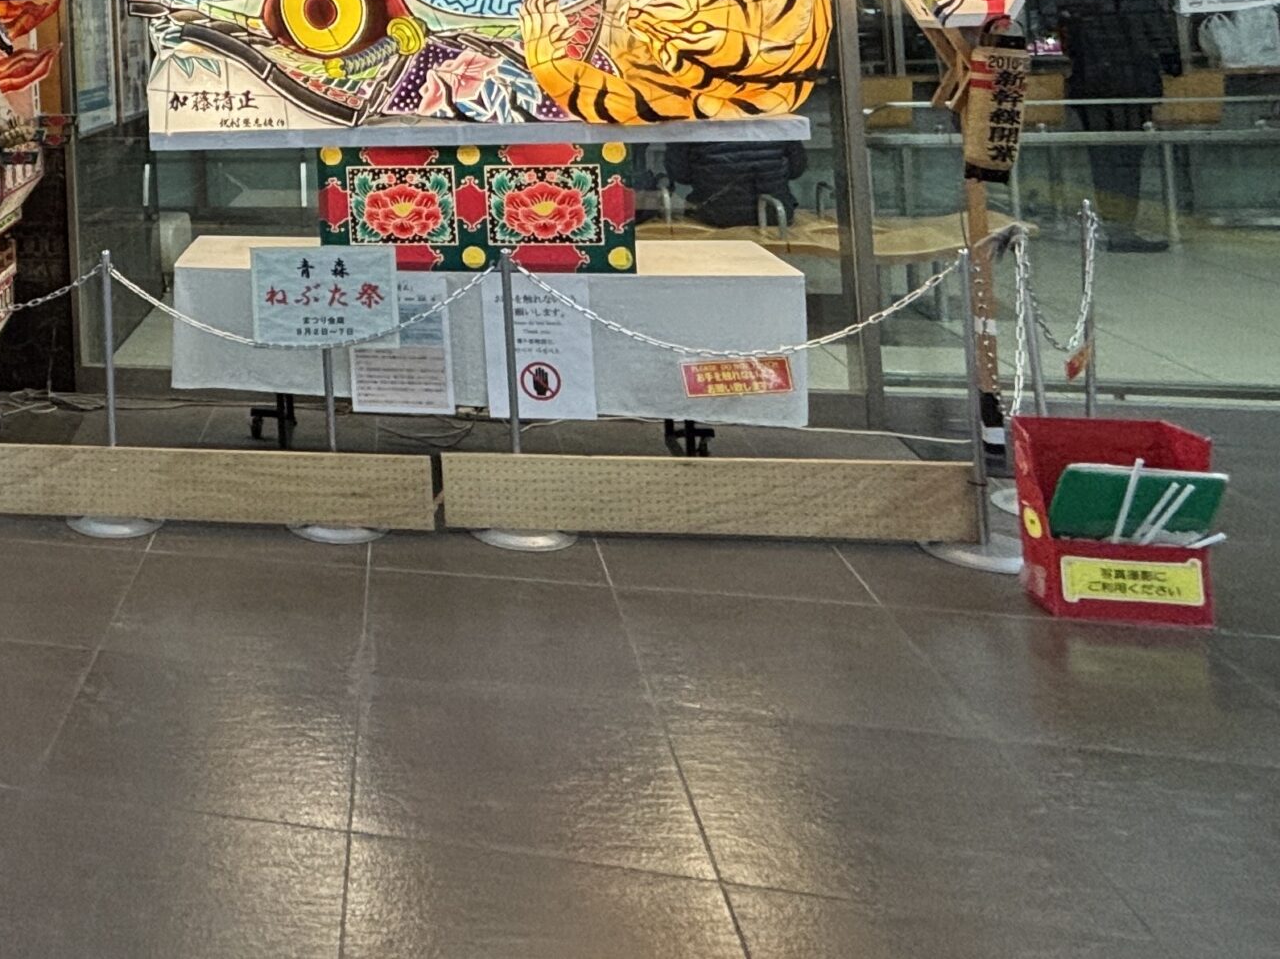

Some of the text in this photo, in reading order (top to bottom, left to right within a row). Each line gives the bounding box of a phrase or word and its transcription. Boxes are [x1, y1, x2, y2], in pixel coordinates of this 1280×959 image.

[169, 91, 260, 112] 加藤清正
[297, 258, 351, 278] 青森
[265, 283, 385, 309] ねぶた祭
